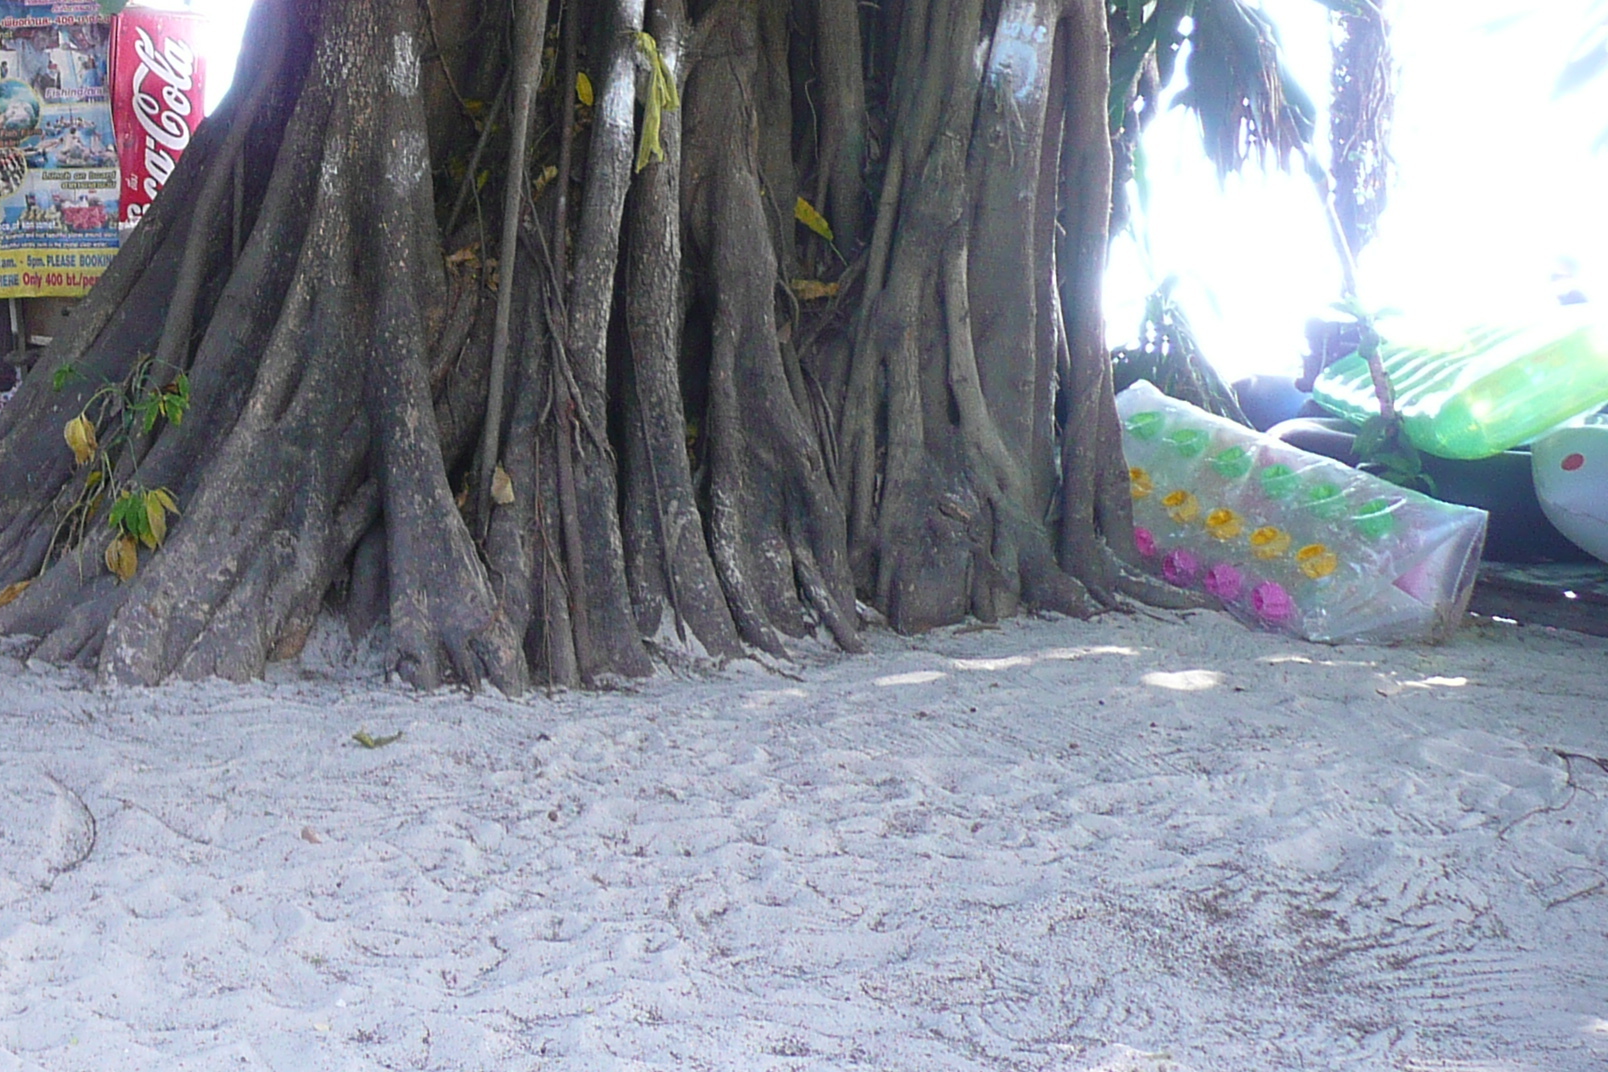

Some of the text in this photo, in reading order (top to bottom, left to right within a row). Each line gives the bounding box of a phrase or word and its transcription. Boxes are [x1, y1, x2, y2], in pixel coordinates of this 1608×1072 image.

[55, 15, 74, 25] 400
[42, 171, 72, 180] Lunch
[26, 255, 44, 269] 5pm.
[47, 254, 76, 268] PLEASE
[79, 253, 114, 267] BOOKIN
[22, 272, 42, 289] Only
[45, 272, 63, 286] 400
[66, 272, 98, 289] bt./per
